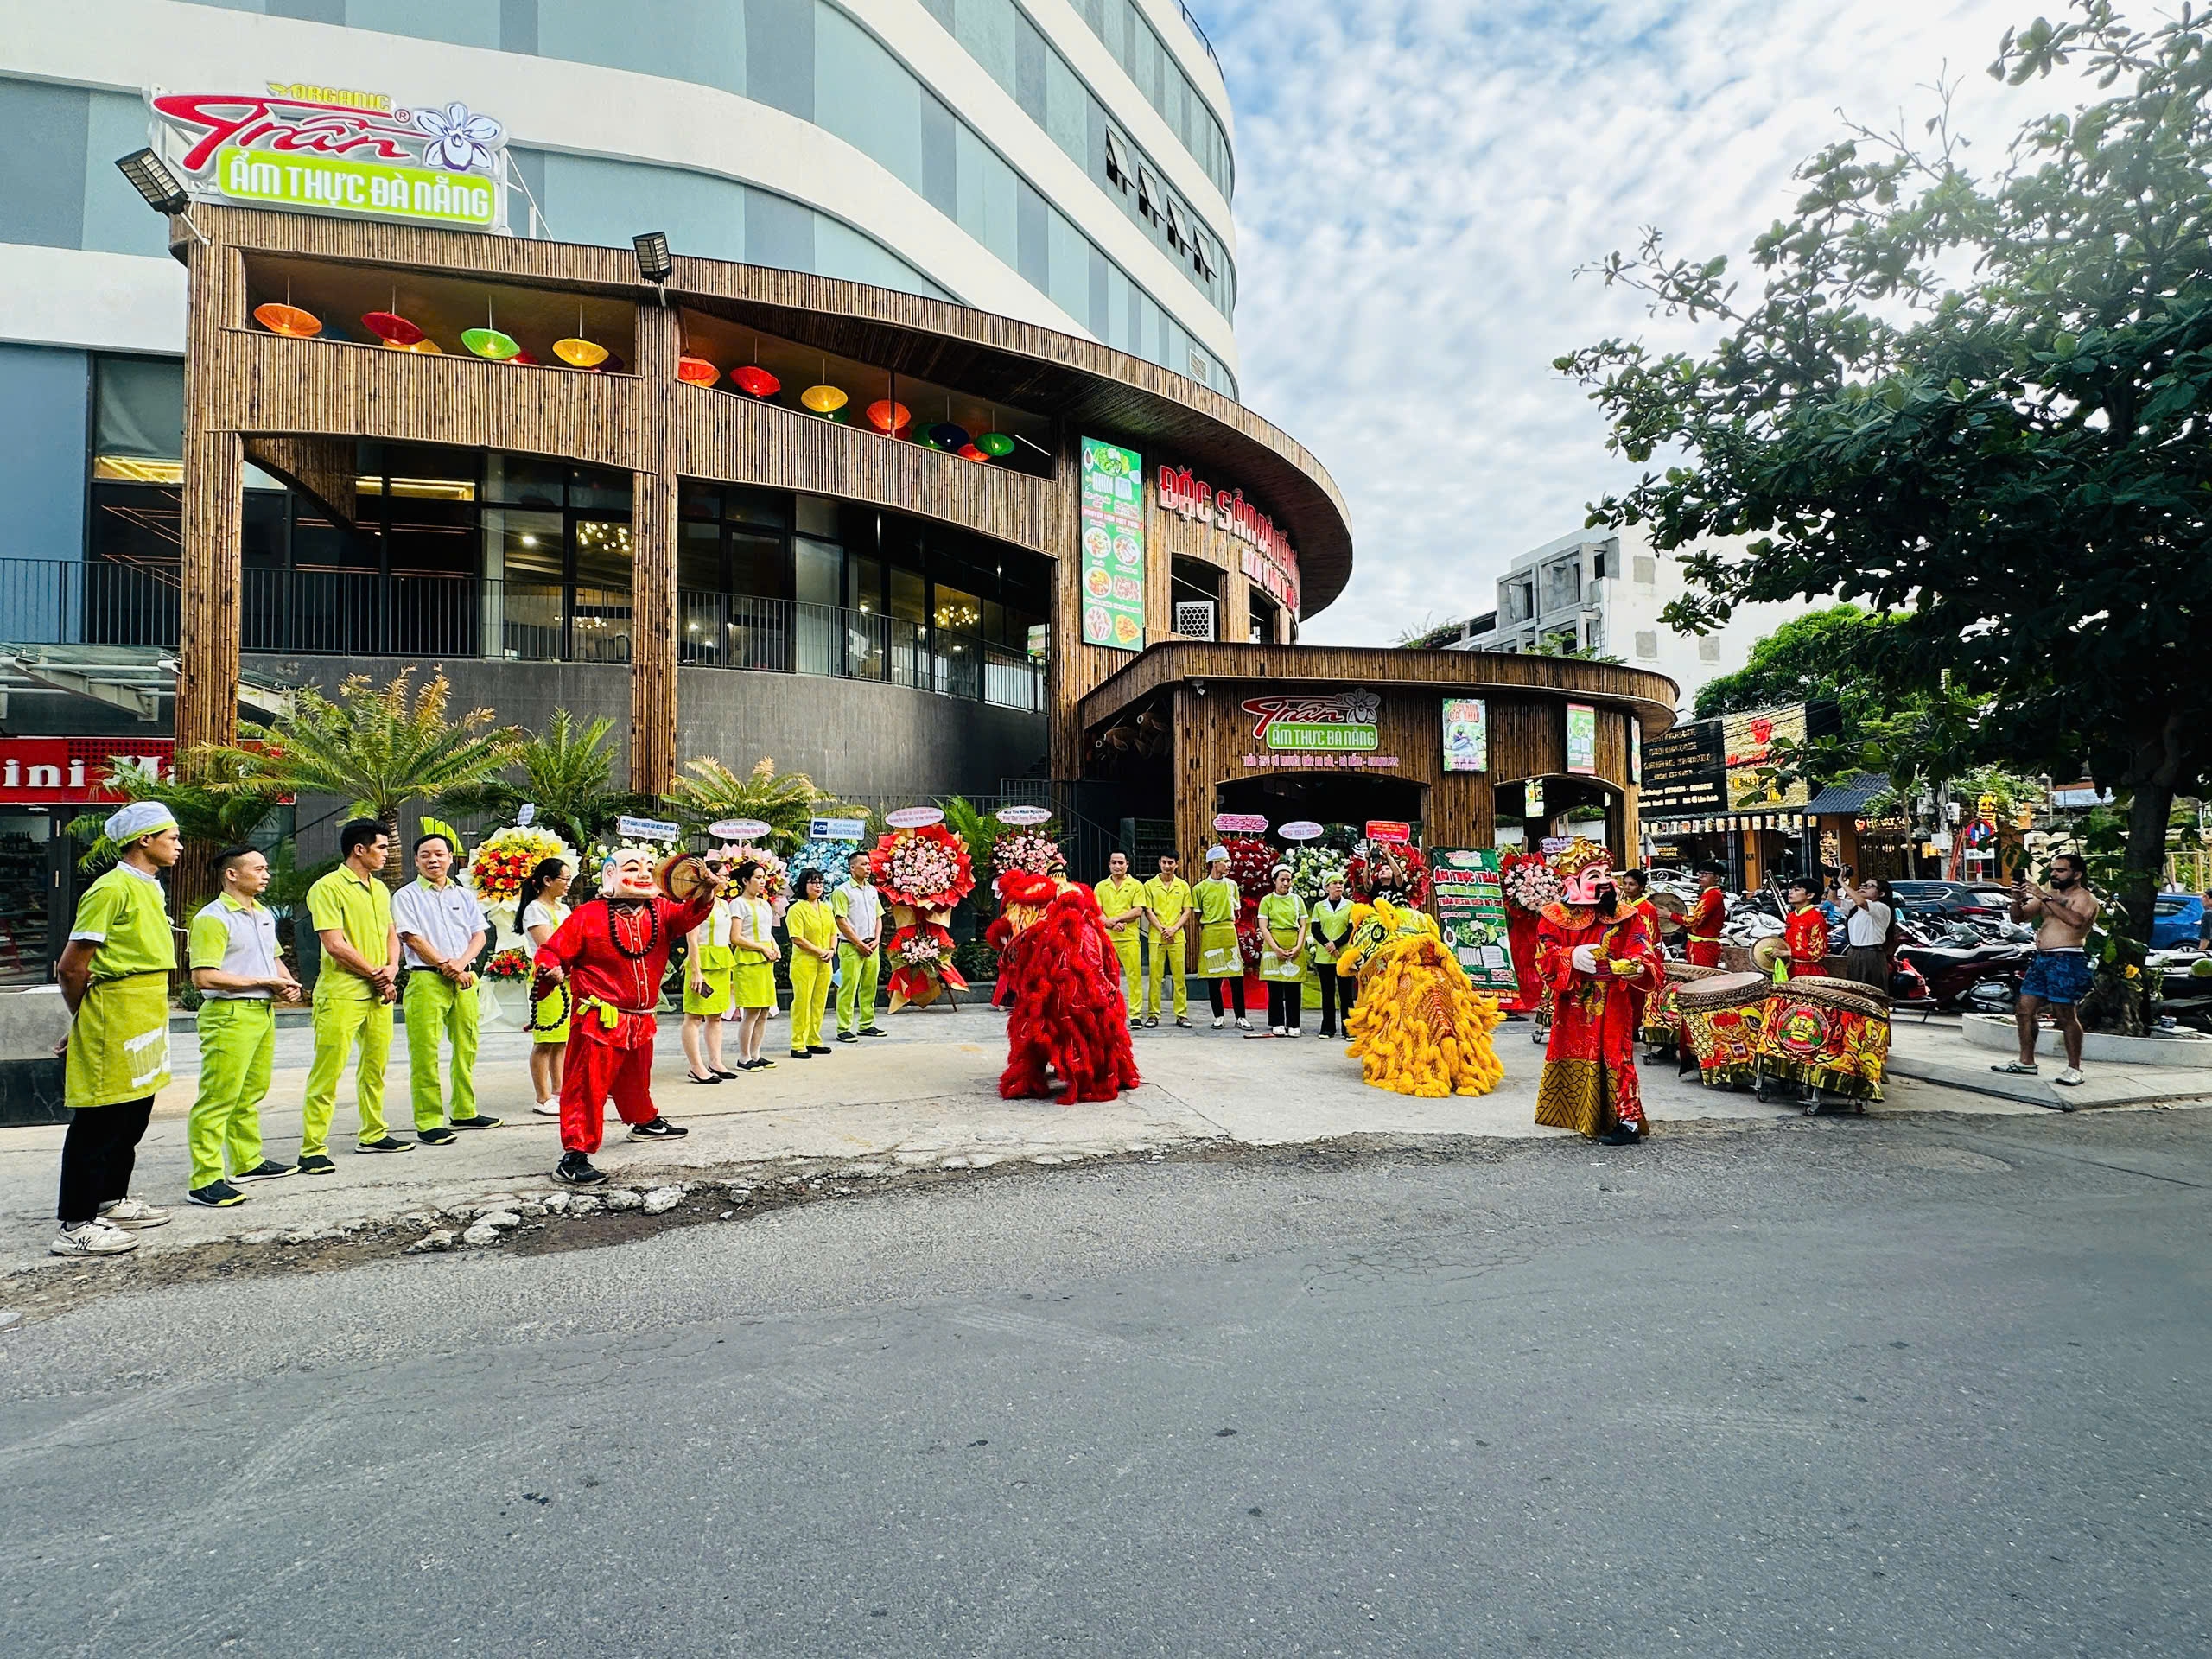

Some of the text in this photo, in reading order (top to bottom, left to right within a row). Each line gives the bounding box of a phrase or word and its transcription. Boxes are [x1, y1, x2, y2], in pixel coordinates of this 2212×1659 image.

[153, 94, 430, 171] Trần
[291, 84, 391, 111] ORGANIC
[230, 149, 489, 219] ẨM THỰC ĐÀ NẴNG
[1157, 465, 1211, 523] ĐẶC
[1215, 487, 1257, 546] SẢN
[1294, 729, 1325, 747] THỰC
